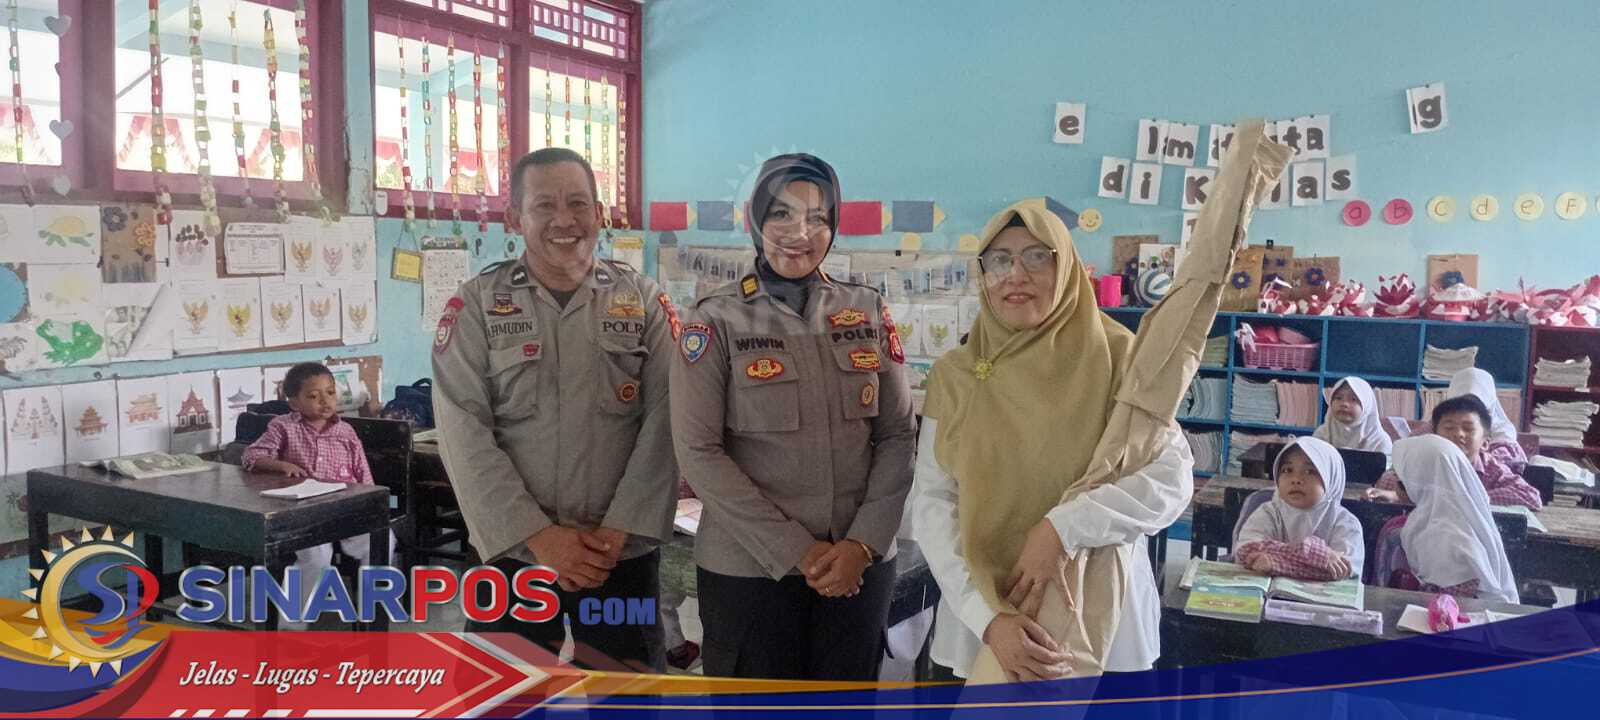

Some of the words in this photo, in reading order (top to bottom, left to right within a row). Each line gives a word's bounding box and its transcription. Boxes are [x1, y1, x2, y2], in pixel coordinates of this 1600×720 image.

[1102, 164, 1152, 200] di
[1476, 198, 1489, 215] d
[1520, 199, 1535, 215] e
[831, 327, 878, 343] POLRI
[735, 337, 785, 351] WIWIN
